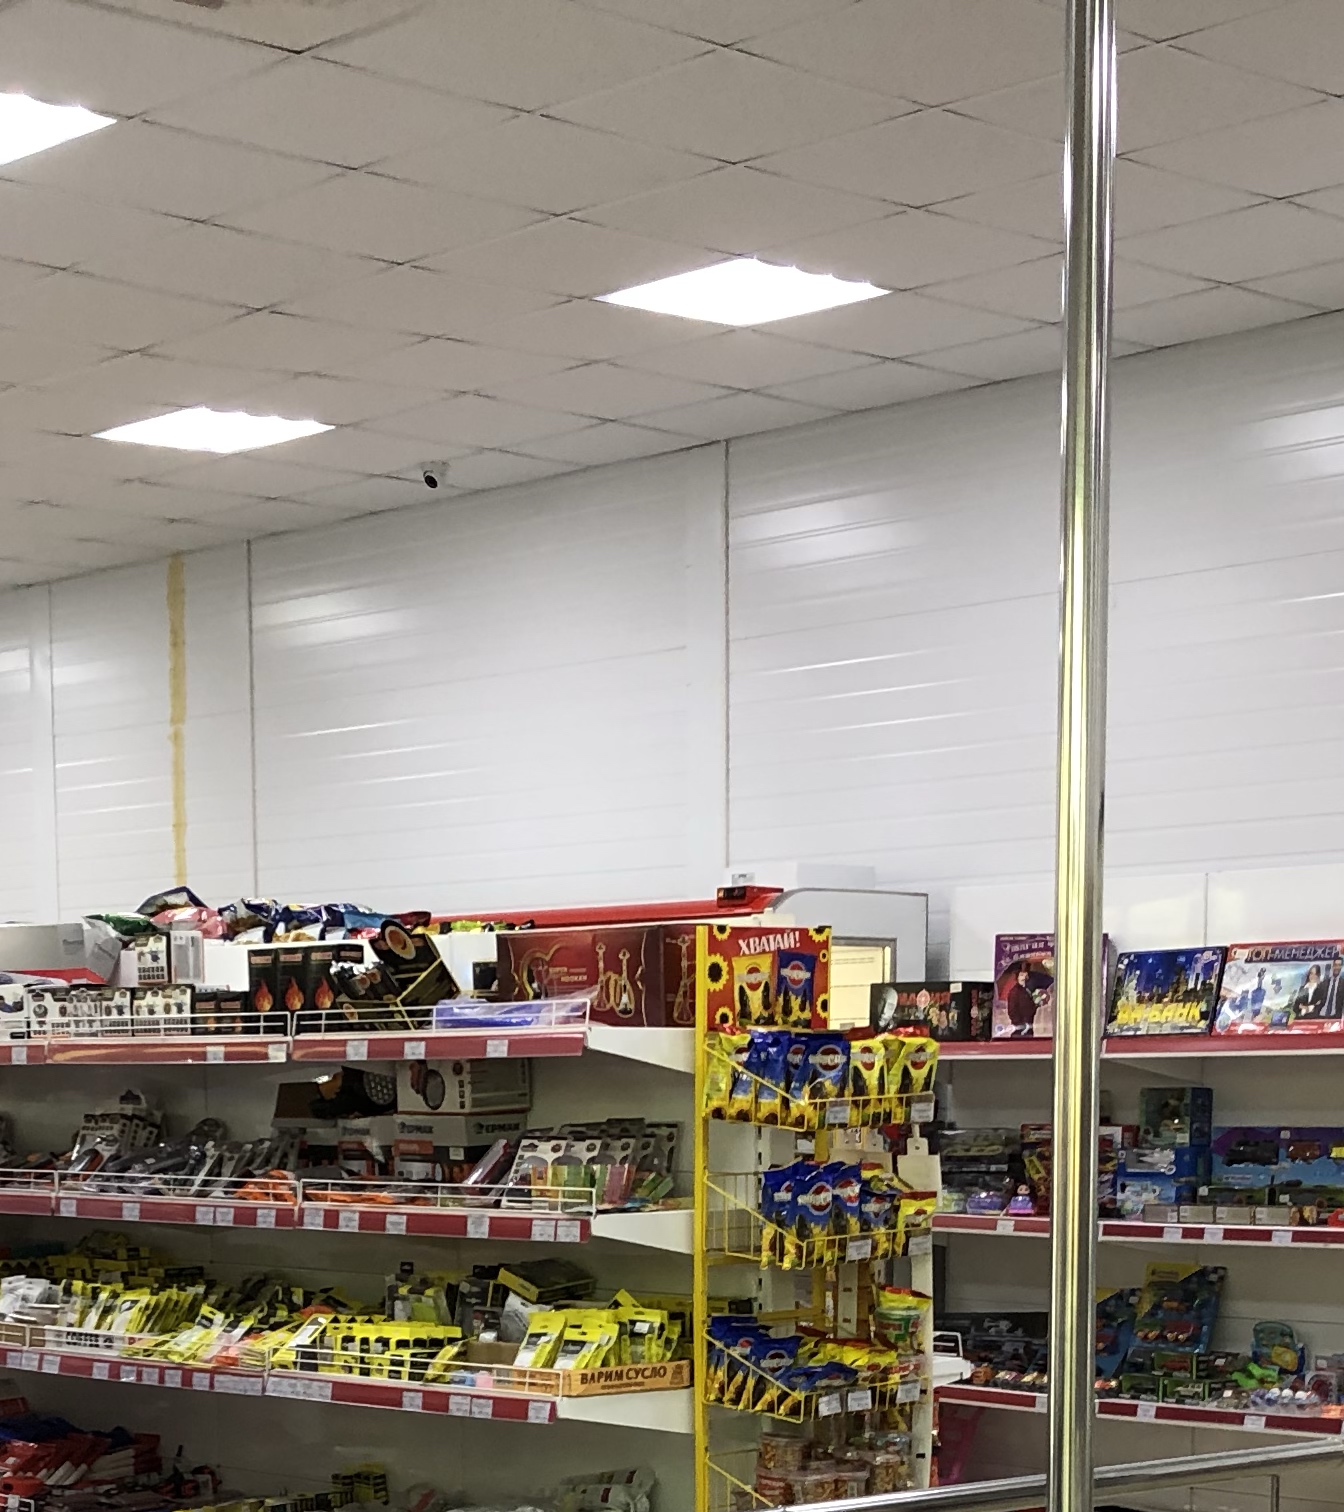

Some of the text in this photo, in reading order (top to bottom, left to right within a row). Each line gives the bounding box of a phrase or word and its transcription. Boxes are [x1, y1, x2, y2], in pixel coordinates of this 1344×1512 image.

[738, 929, 801, 956] ХВАТАЙ!
[580, 1365, 668, 1385] ВАРИМ СУСЛО
